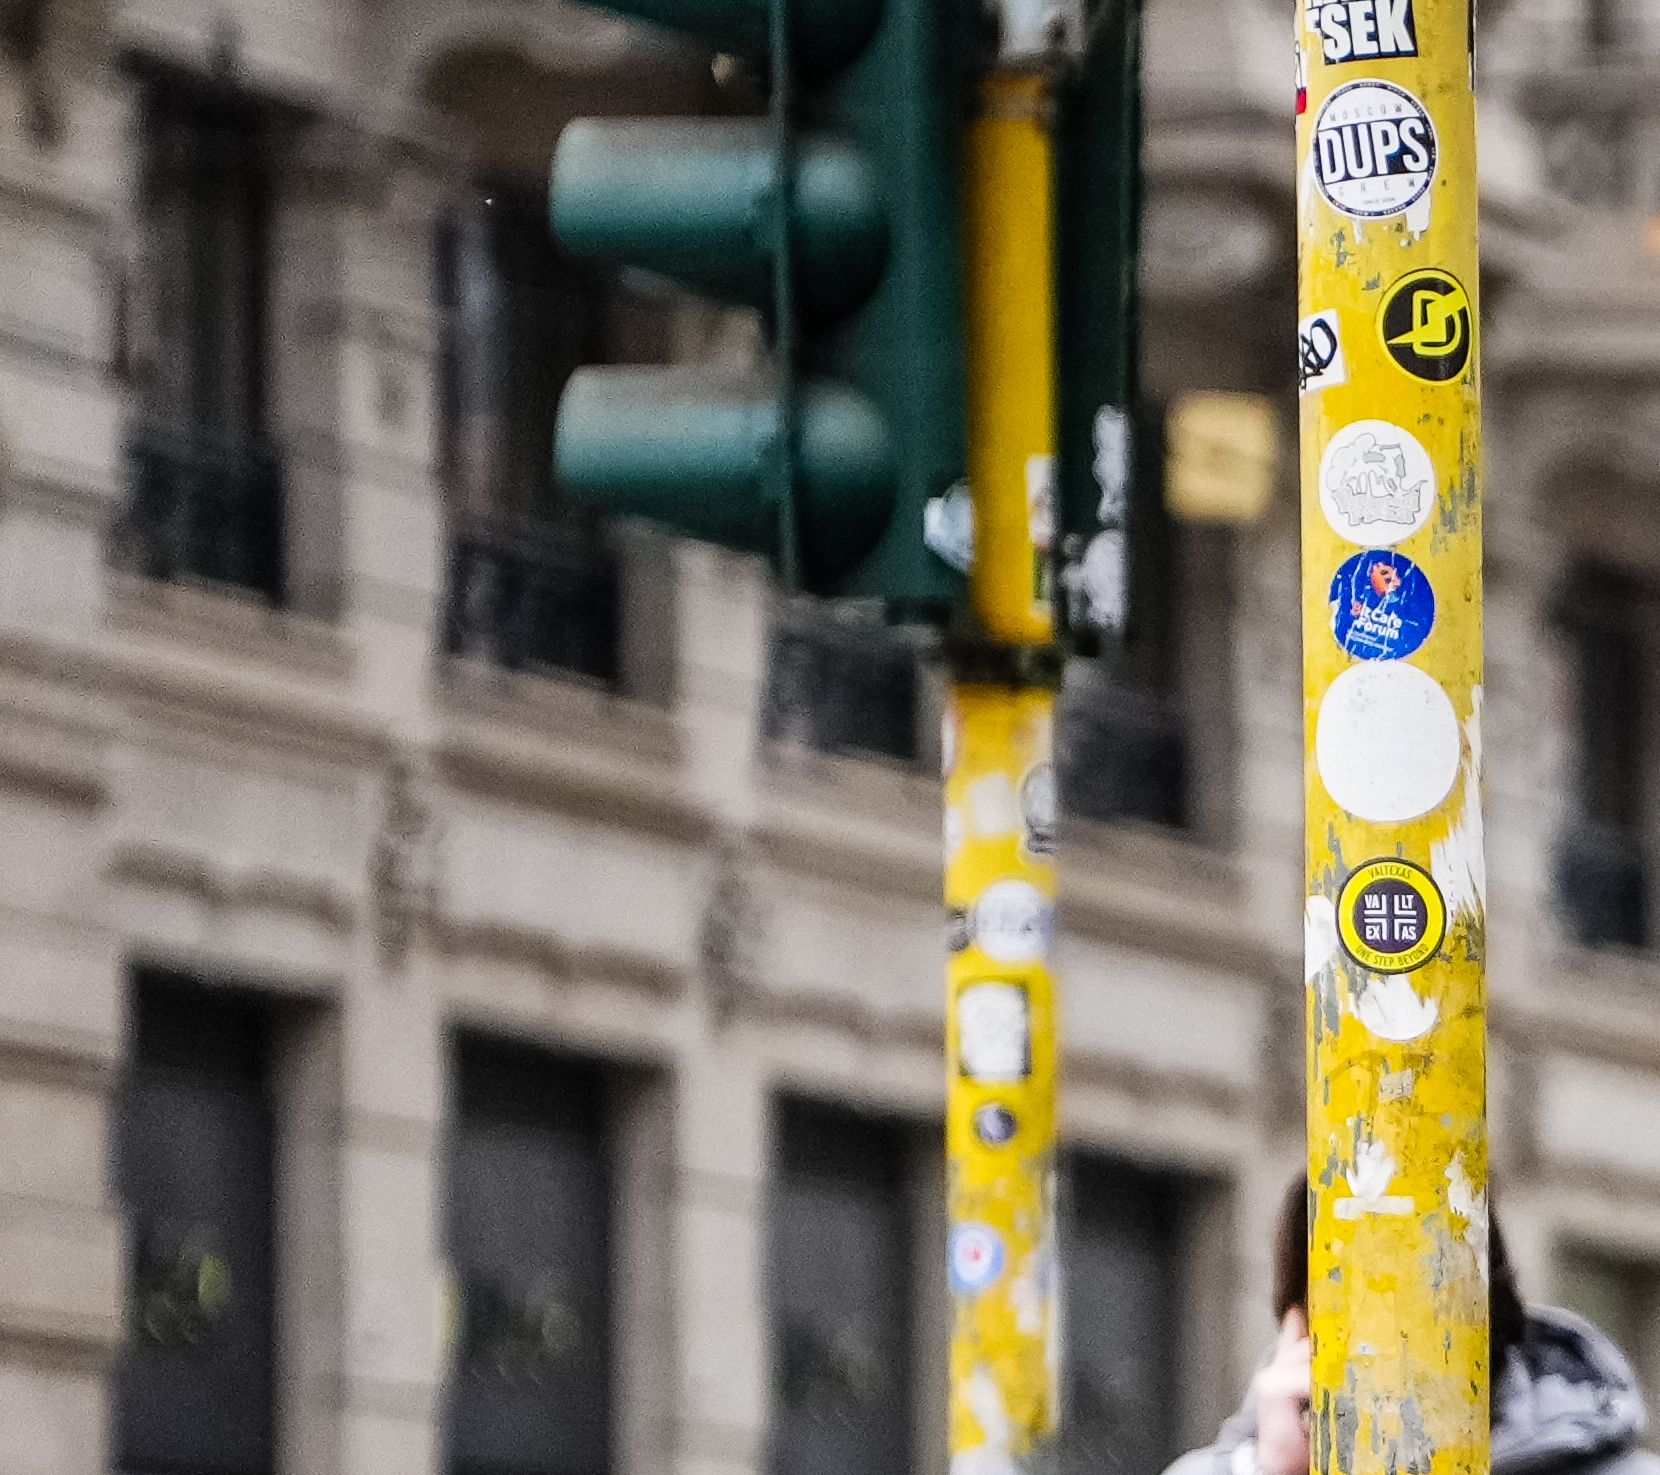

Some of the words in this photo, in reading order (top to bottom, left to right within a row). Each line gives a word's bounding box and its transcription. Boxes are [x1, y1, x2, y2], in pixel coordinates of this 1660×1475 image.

[1320, 0, 1415, 60] SEK
[1329, 103, 1403, 121] MOSCOW
[1318, 117, 1429, 183] DUPS
[1338, 176, 1416, 196] CREW
[1367, 864, 1413, 880] VALTEXAS
[1373, 954, 1395, 967] STEP
